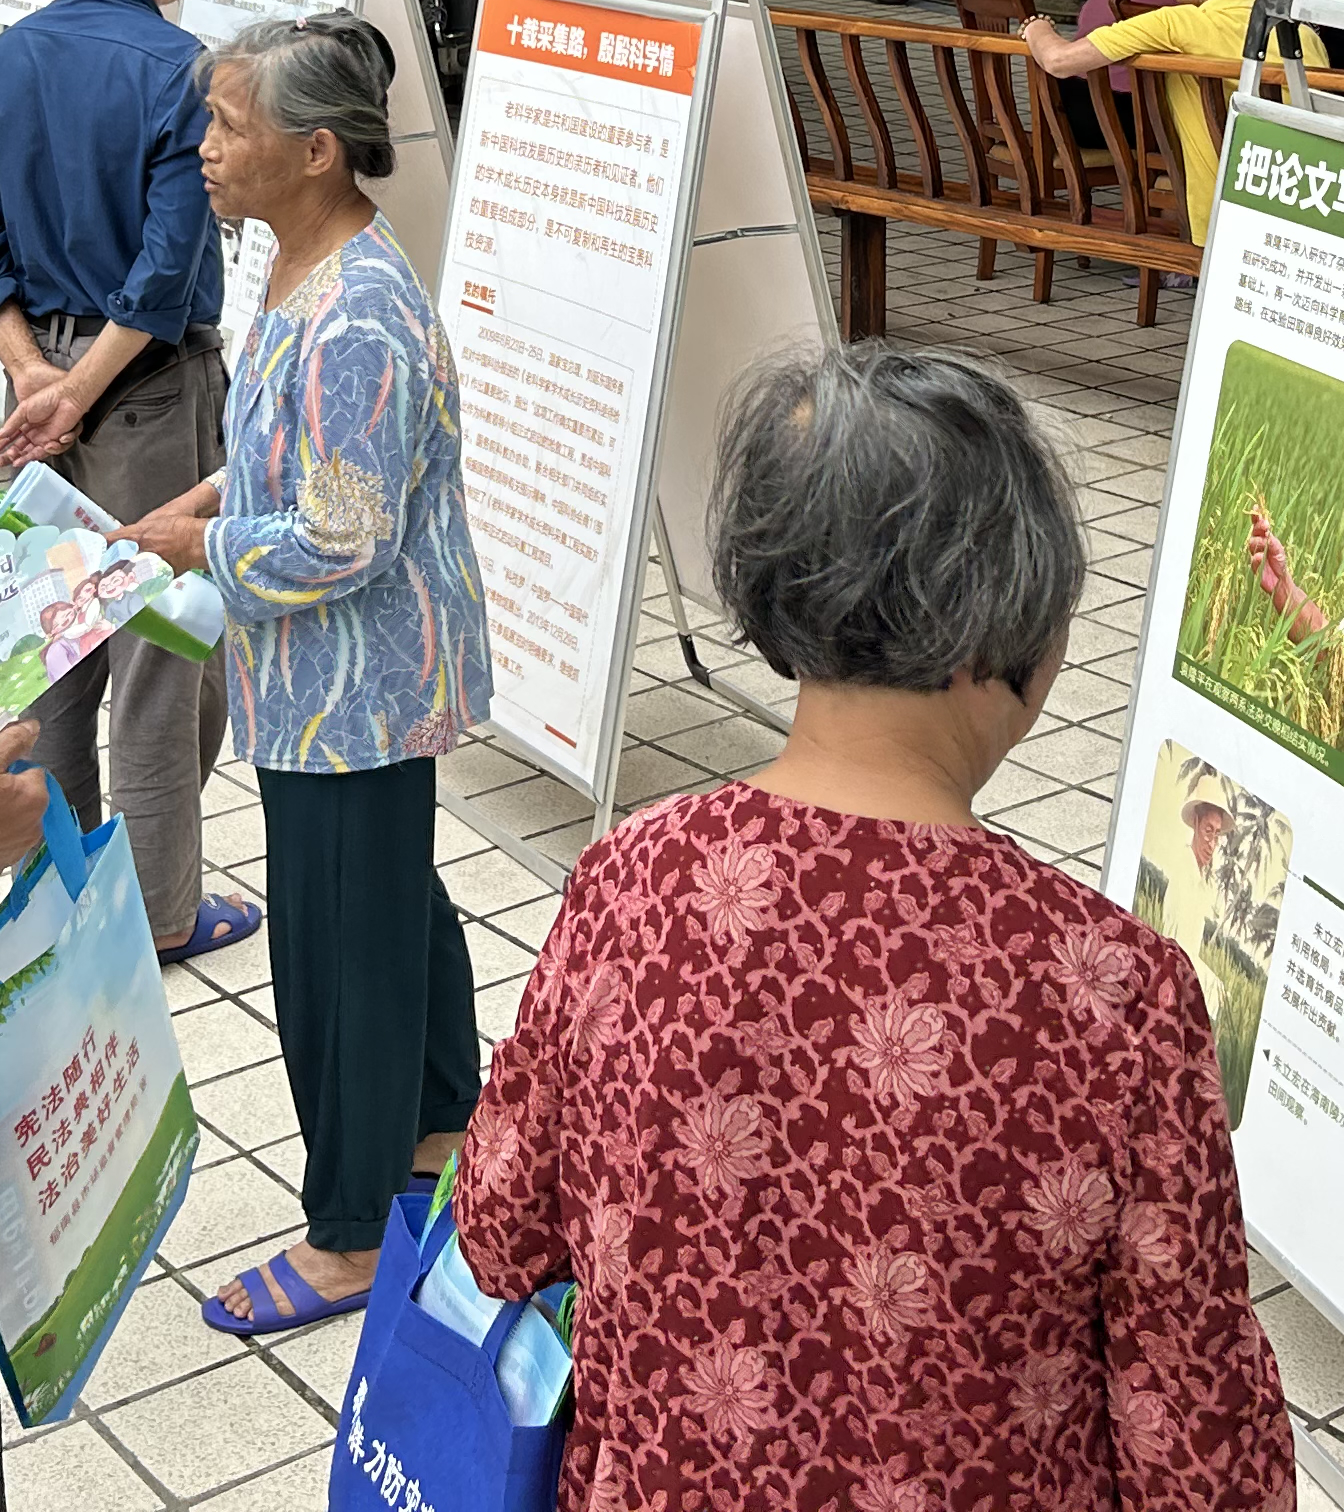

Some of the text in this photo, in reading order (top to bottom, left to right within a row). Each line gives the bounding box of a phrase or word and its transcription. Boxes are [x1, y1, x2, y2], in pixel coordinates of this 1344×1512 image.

[14, 1024, 96, 1148] 宪法随行
[26, 1031, 118, 1181] 民法典相伴
[38, 1036, 140, 1216] 法治美好生活
